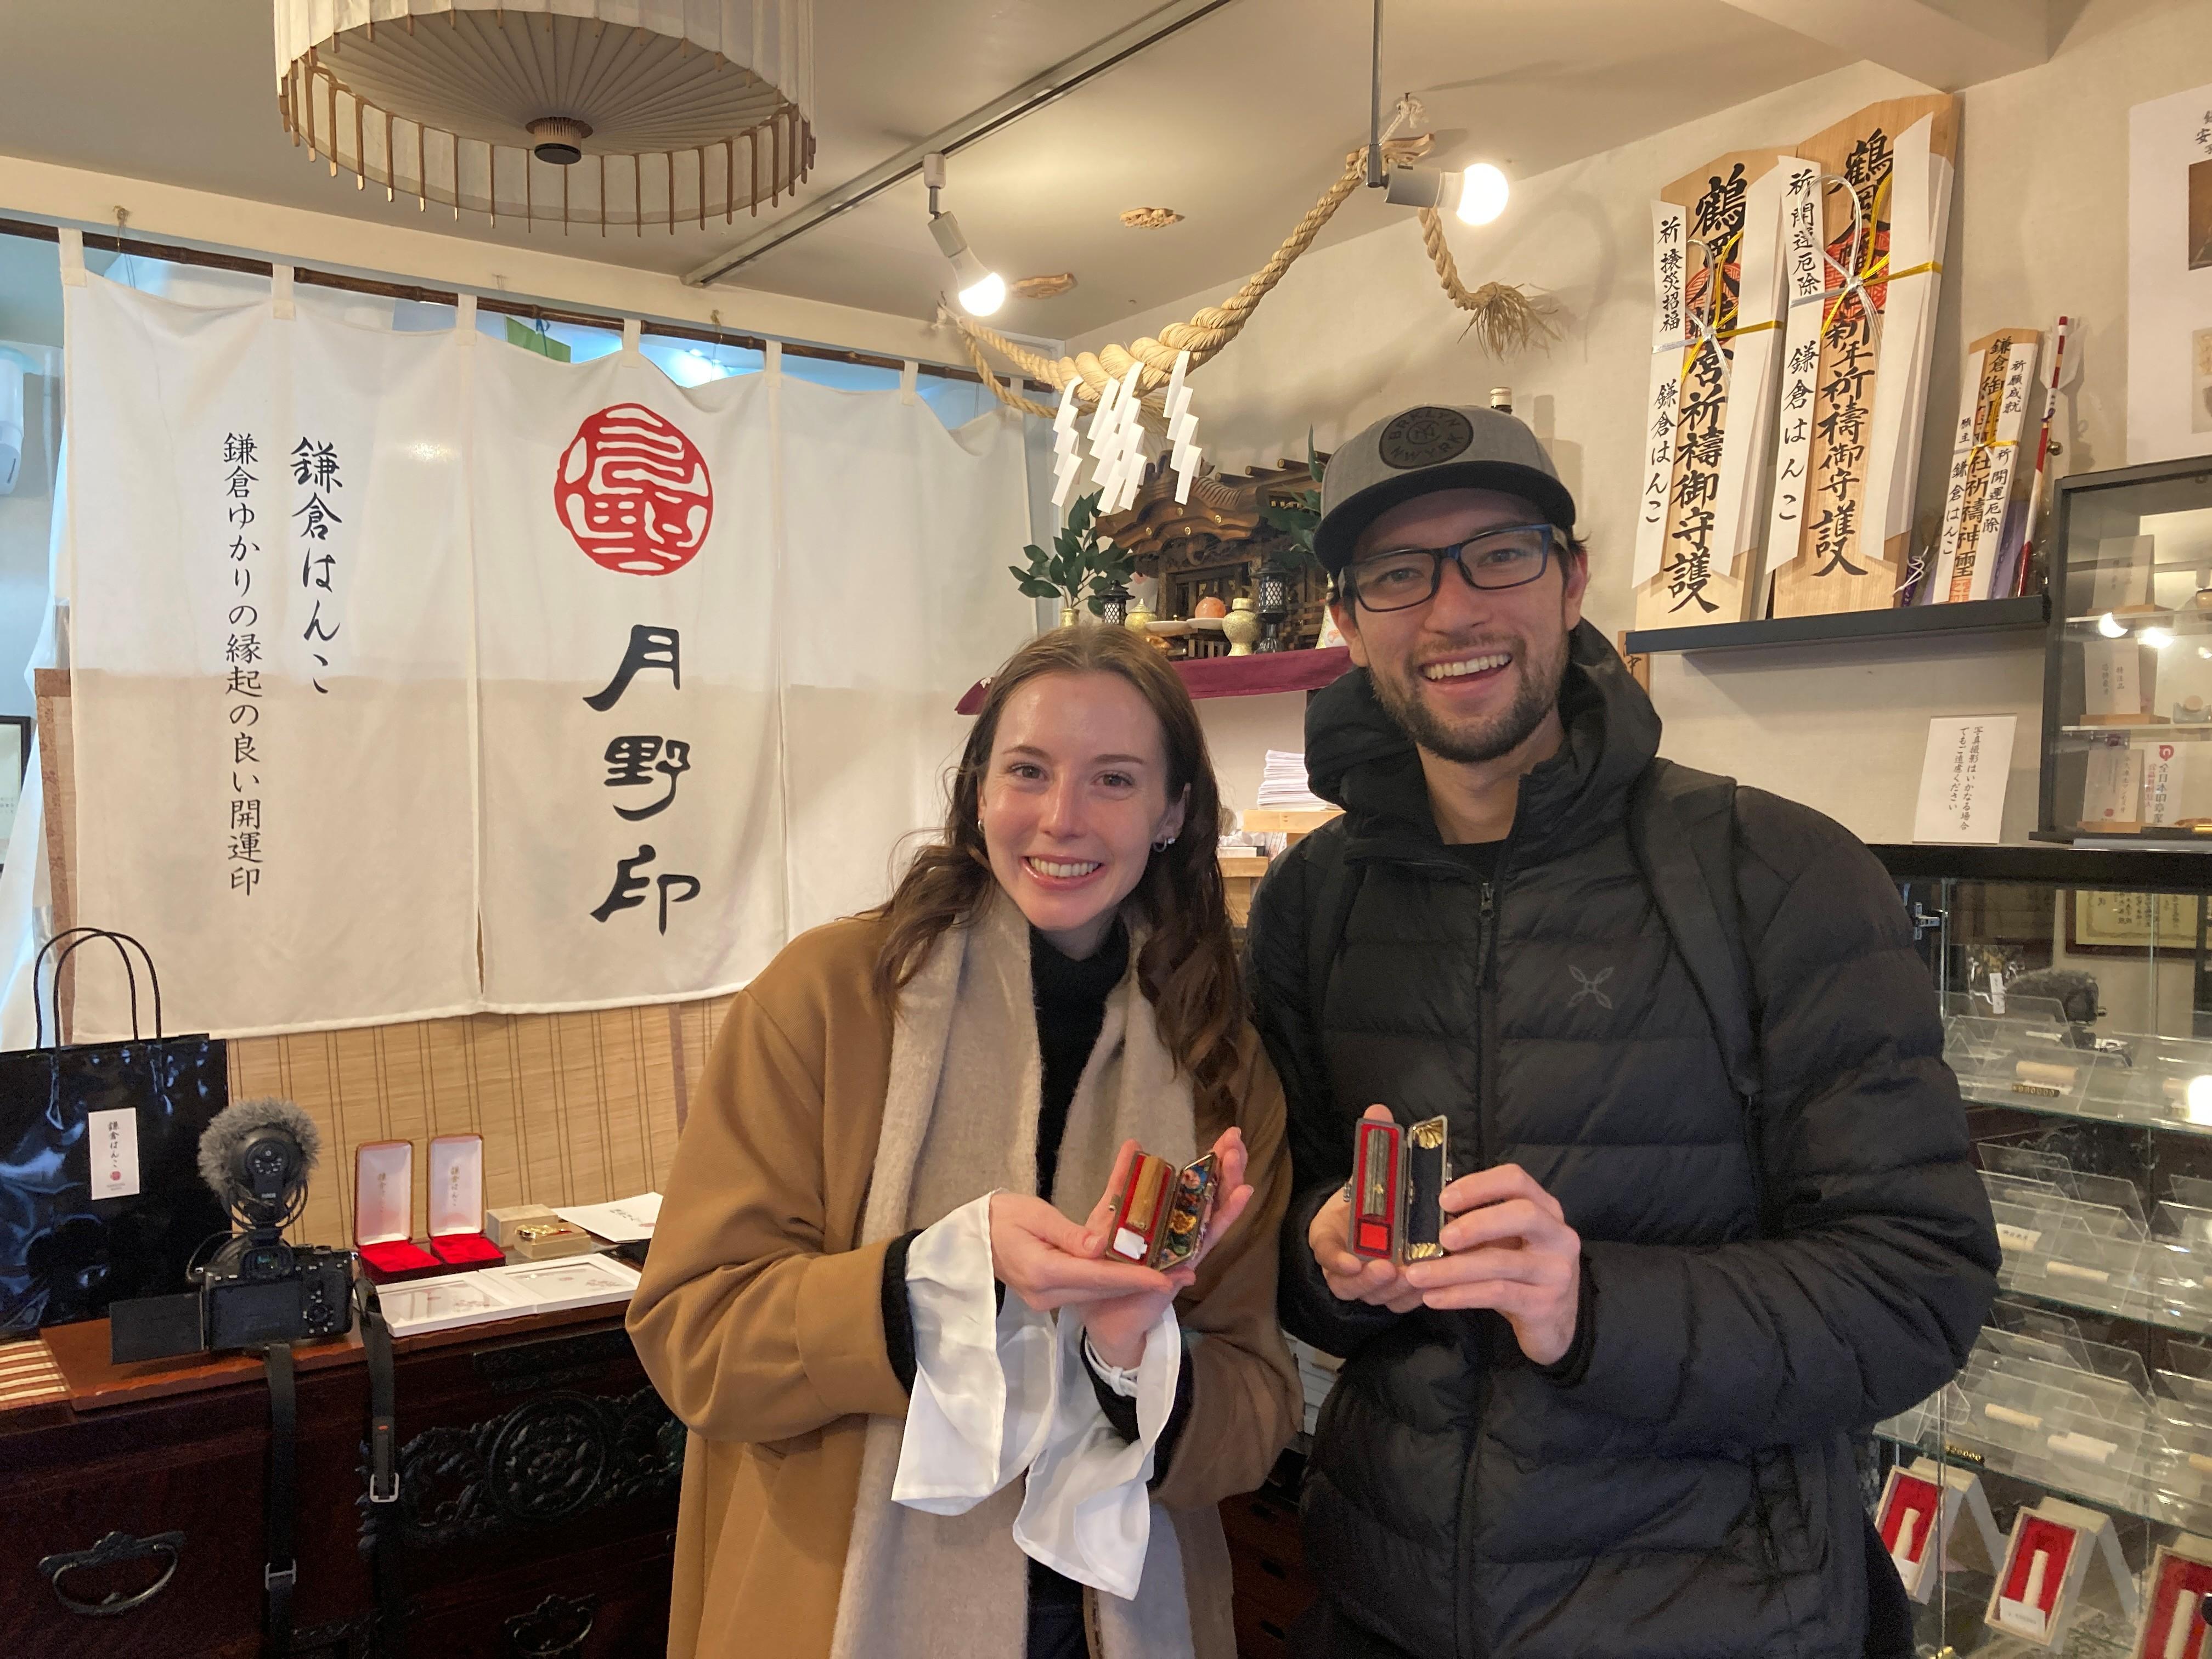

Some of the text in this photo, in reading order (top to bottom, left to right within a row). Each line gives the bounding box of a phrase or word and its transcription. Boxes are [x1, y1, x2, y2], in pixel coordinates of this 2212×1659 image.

[1657, 216, 1681, 244] 祈
[1786, 169, 1815, 198] 祈
[1389, 410, 1460, 439] BRKLYN
[1779, 340, 1819, 521] 鎌倉はんこ
[2002, 360, 2027, 414] 祈願成就
[1645, 379, 1678, 523] 鎌倉はんこ
[1982, 448, 2011, 533] 祈 開運厄除
[1943, 461, 1968, 555] 鎌倉はんこ
[290, 437, 343, 694] 鎌倉はんこ
[224, 432, 262, 896] 鎌倉ゆかりの縁起の良い開運印
[583, 624, 701, 937] 月野印
[1949, 727, 1970, 810] でもご遠慮ください
[1960, 726, 1984, 830] 写真撮影はいかなる場合
